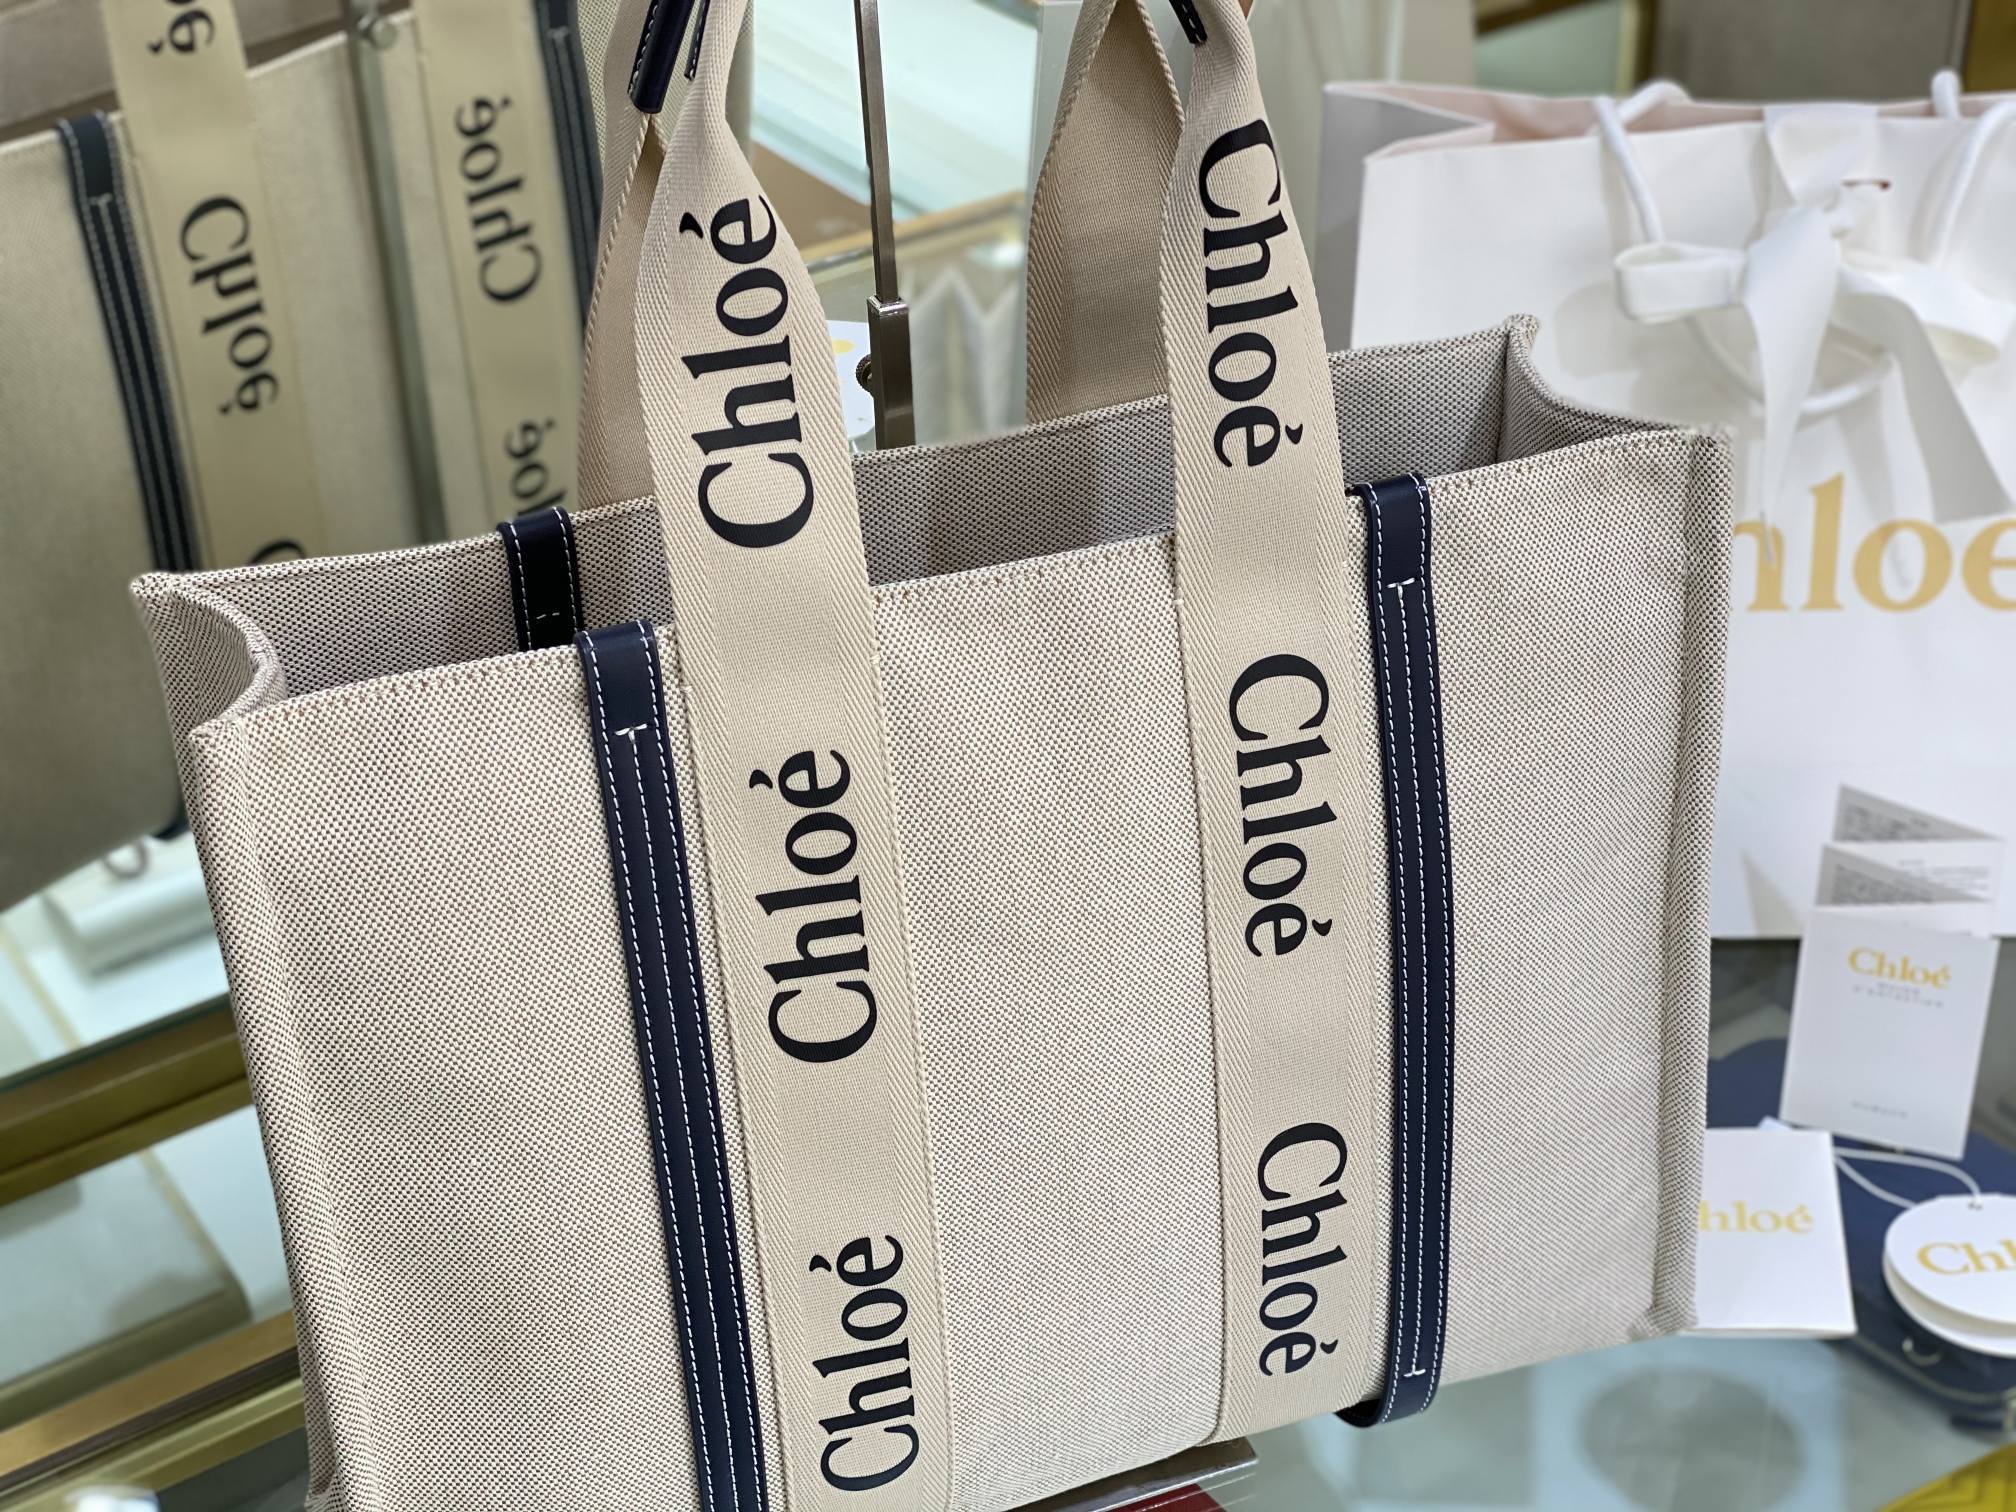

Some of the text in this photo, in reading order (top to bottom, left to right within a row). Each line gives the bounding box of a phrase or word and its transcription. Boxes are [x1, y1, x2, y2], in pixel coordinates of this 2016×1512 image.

[678, 195, 814, 549] Chloé
[1199, 119, 1304, 468] Chloé
[748, 749, 878, 1064] Chloé
[1229, 653, 1338, 957] Chloé
[1847, 946, 1952, 991] Chloé
[808, 1234, 920, 1492] Chloé
[1257, 1122, 1348, 1377] Chloé
